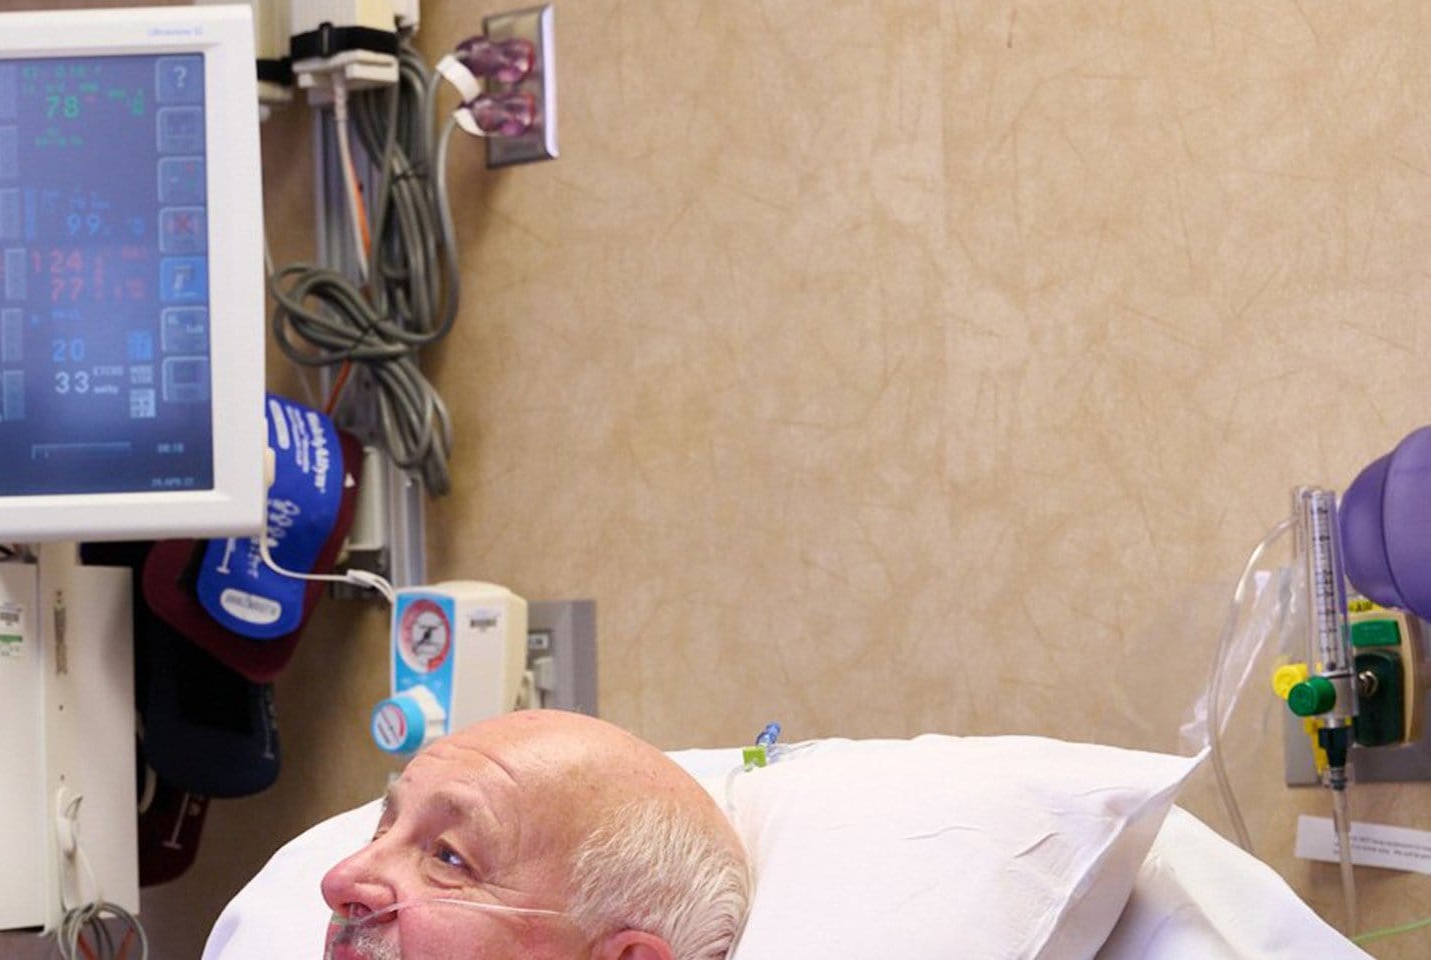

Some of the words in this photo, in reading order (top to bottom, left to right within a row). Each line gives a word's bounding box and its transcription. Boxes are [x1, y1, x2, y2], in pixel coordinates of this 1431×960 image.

[46, 95, 80, 118] 78
[67, 213, 101, 236] 99
[52, 338, 85, 362] 20
[54, 371, 90, 395] 33
